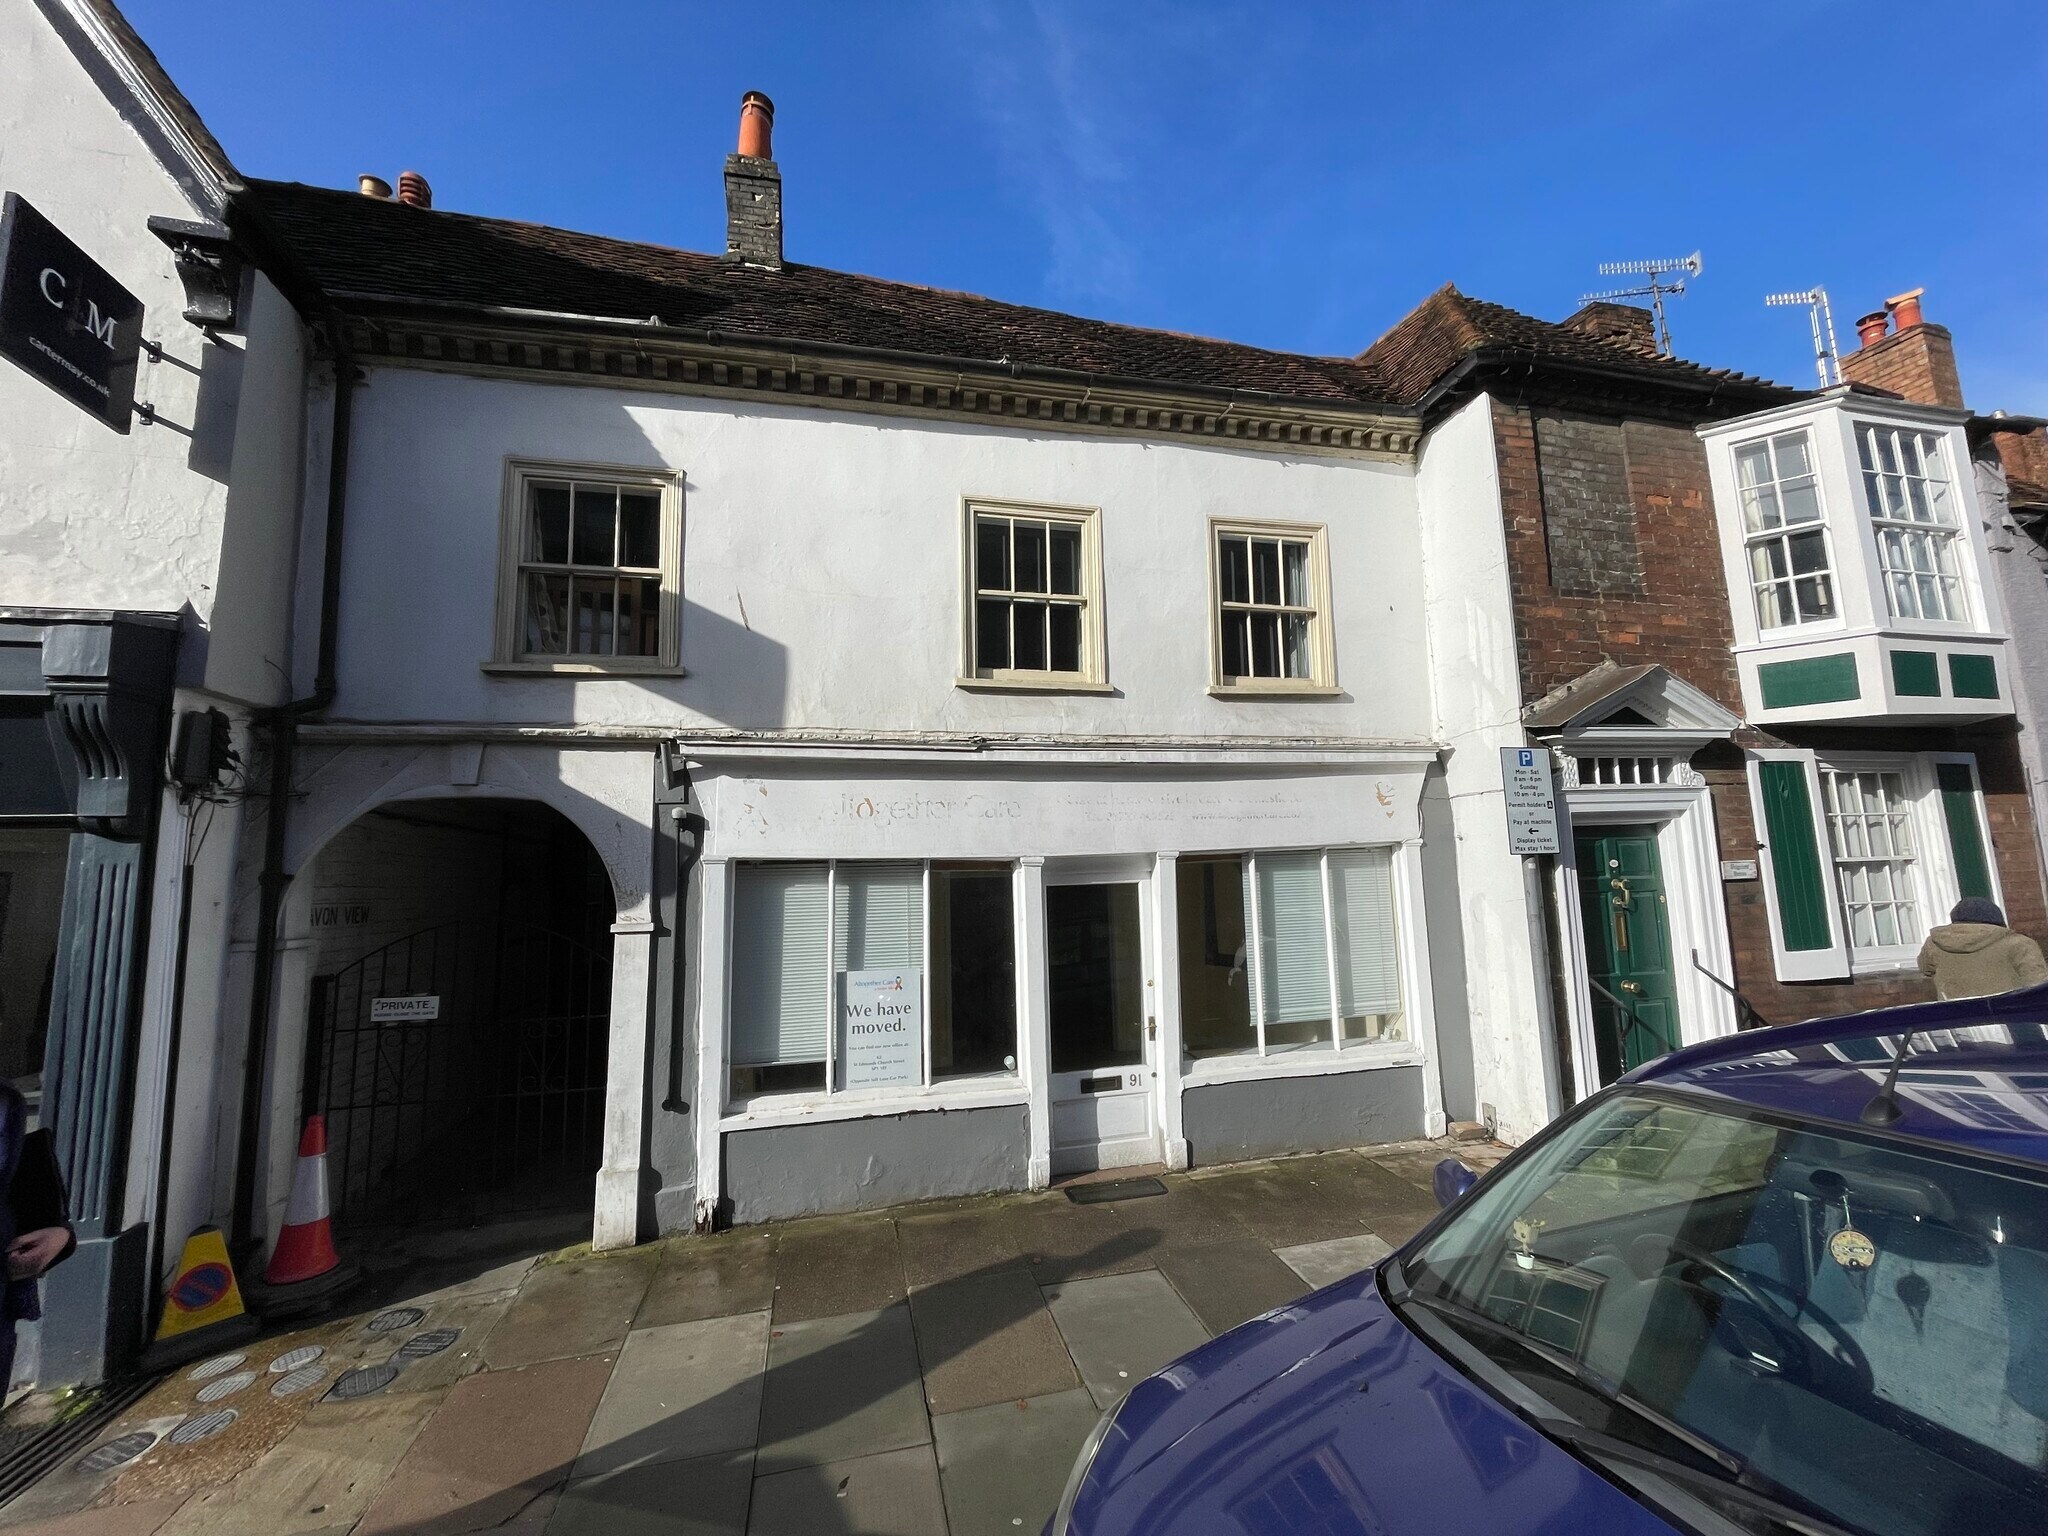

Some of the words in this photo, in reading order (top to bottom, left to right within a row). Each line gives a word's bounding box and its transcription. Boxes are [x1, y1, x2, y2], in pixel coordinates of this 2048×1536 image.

[40, 268, 66, 309] C
[85, 299, 118, 350] M
[29, 336, 111, 398] cartermay.co.uk
[1521, 752, 1531, 766] P
[345, 906, 370, 924] VIEW
[381, 1000, 430, 1010] PRIVATE
[847, 1004, 872, 1018] We
[878, 1002, 912, 1016] have
[852, 1018, 906, 1034] moved.
[1130, 1073, 1142, 1086] 91
